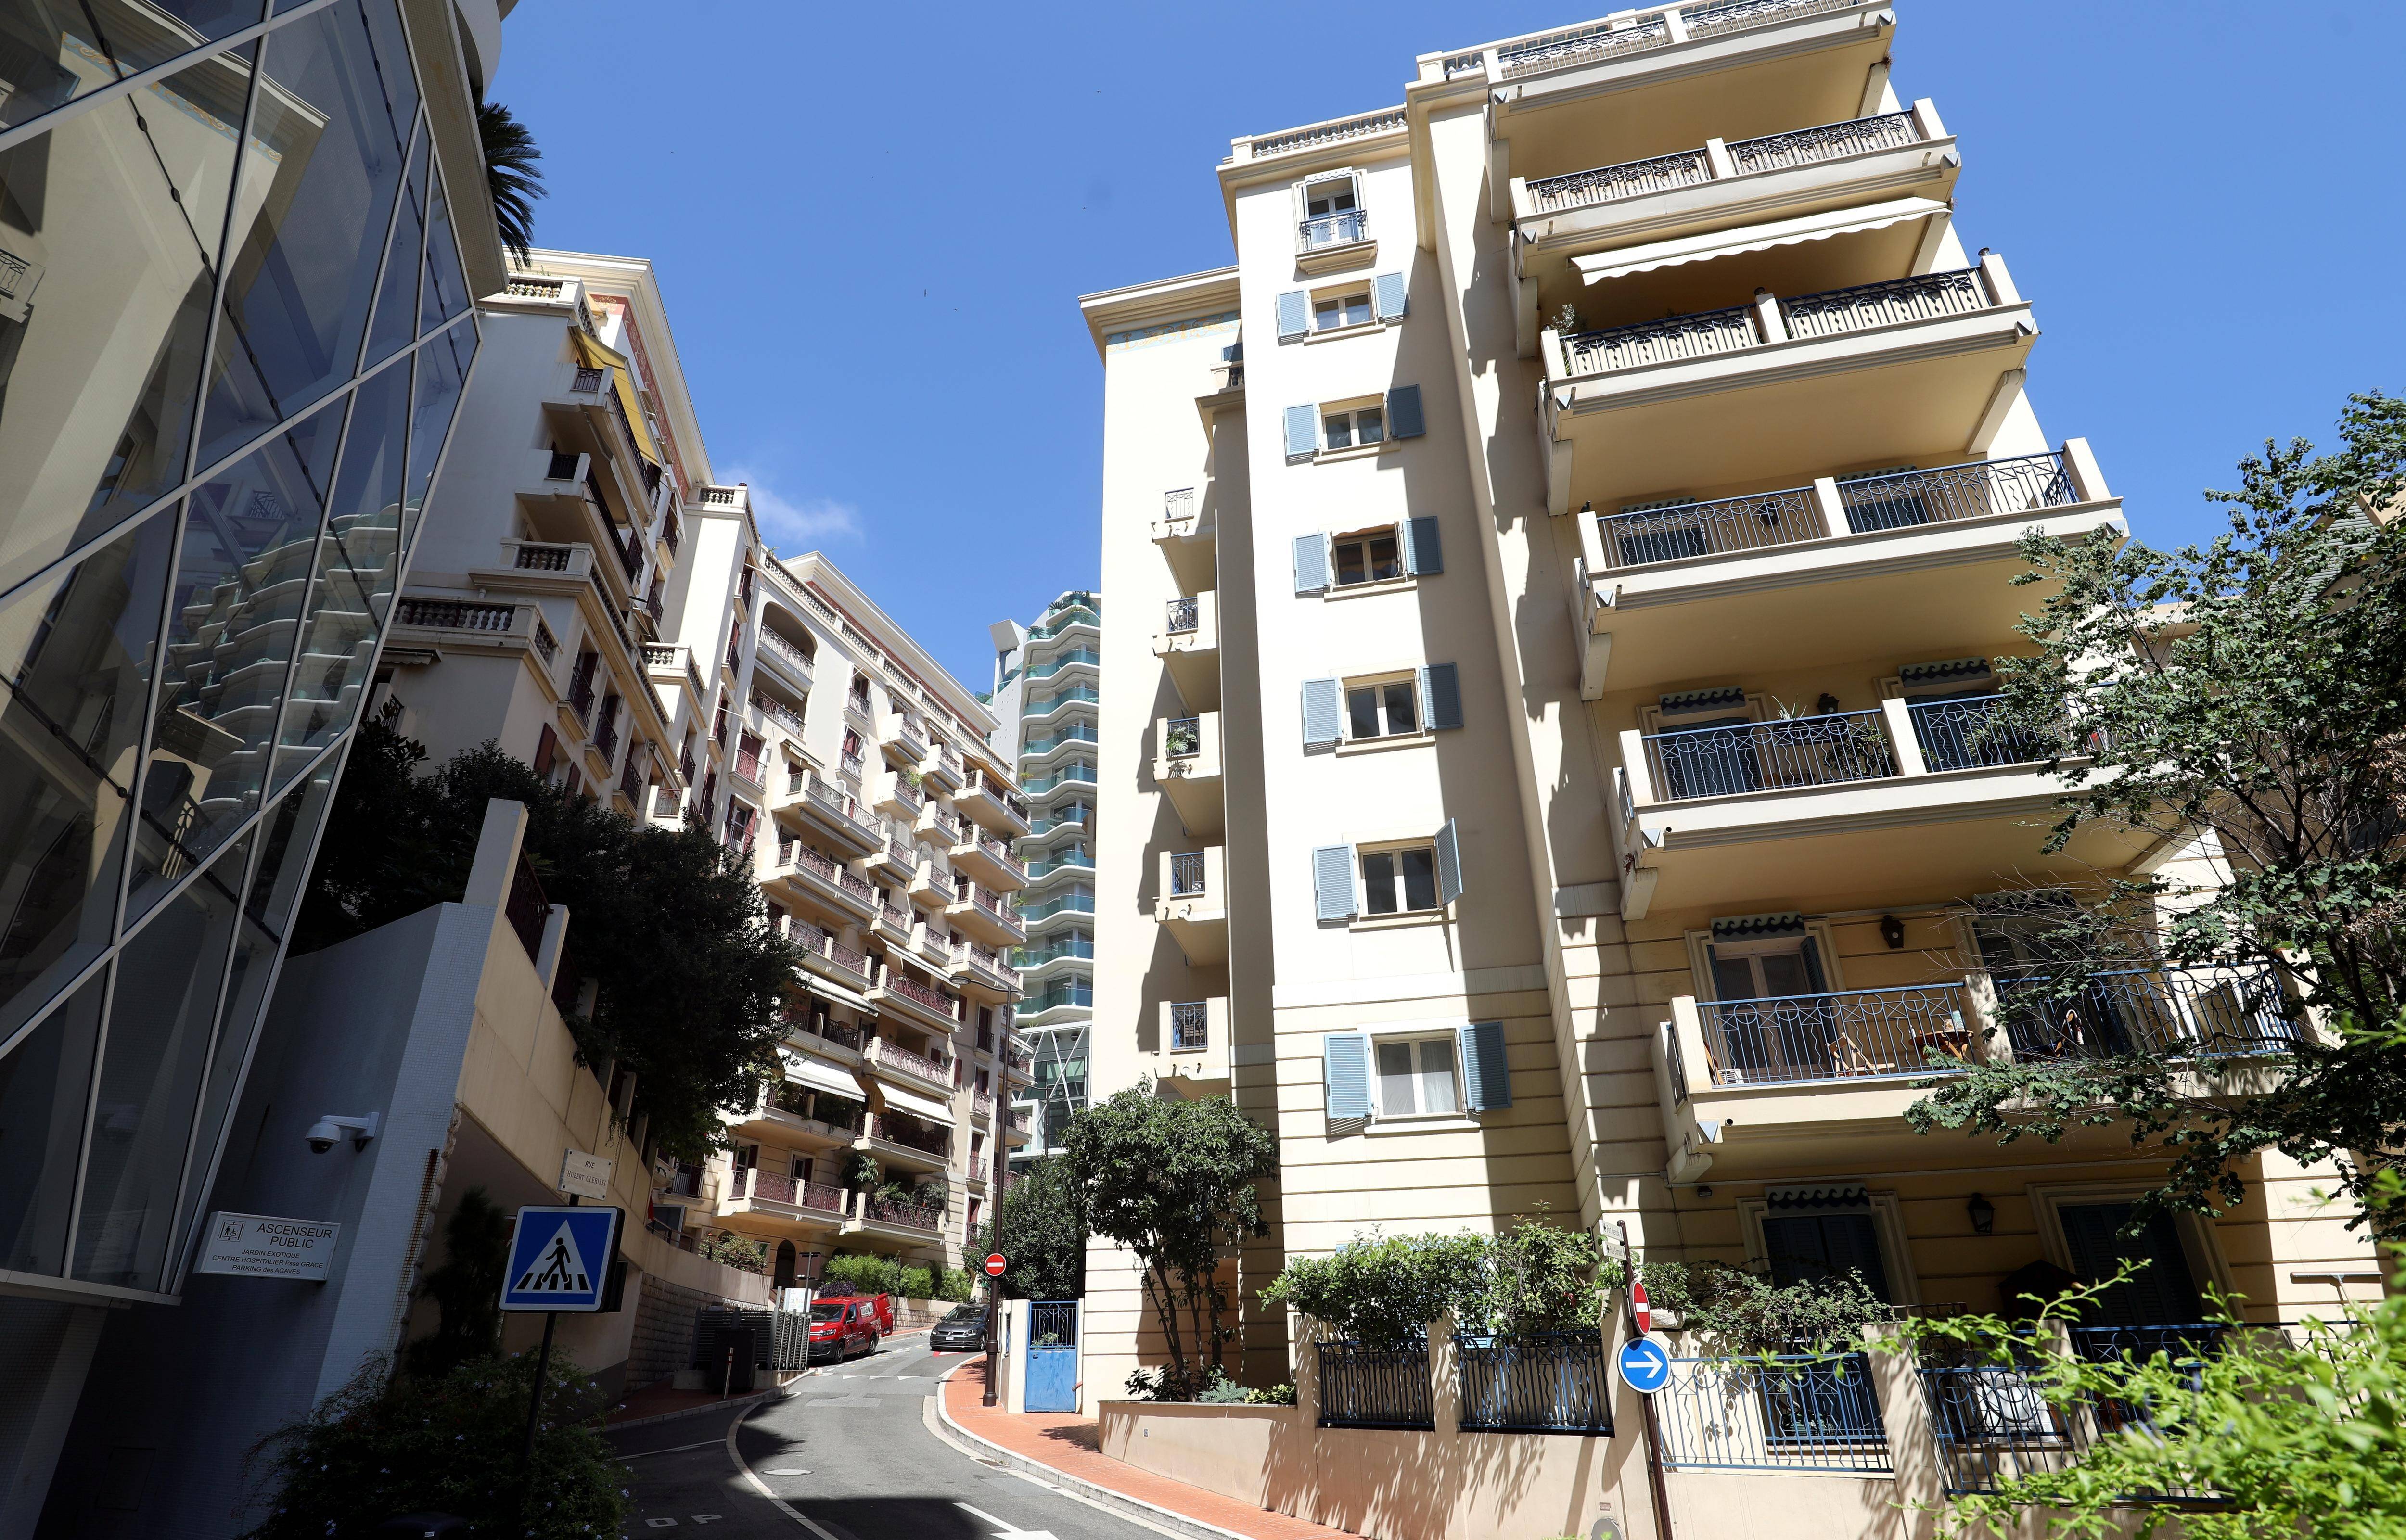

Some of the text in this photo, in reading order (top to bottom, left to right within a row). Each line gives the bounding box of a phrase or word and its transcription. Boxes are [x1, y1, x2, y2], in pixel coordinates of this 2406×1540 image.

[585, 1160, 595, 1169] RUE
[567, 1170, 606, 1186] HUBERT CLERISSI
[256, 1223, 332, 1238] ASCENSEUR
[269, 1236, 314, 1248] PUBLIC
[267, 1250, 300, 1259] EXOTIQUE
[241, 1257, 283, 1265] HOSPITALIER
[232, 1264, 261, 1273] PARKING
